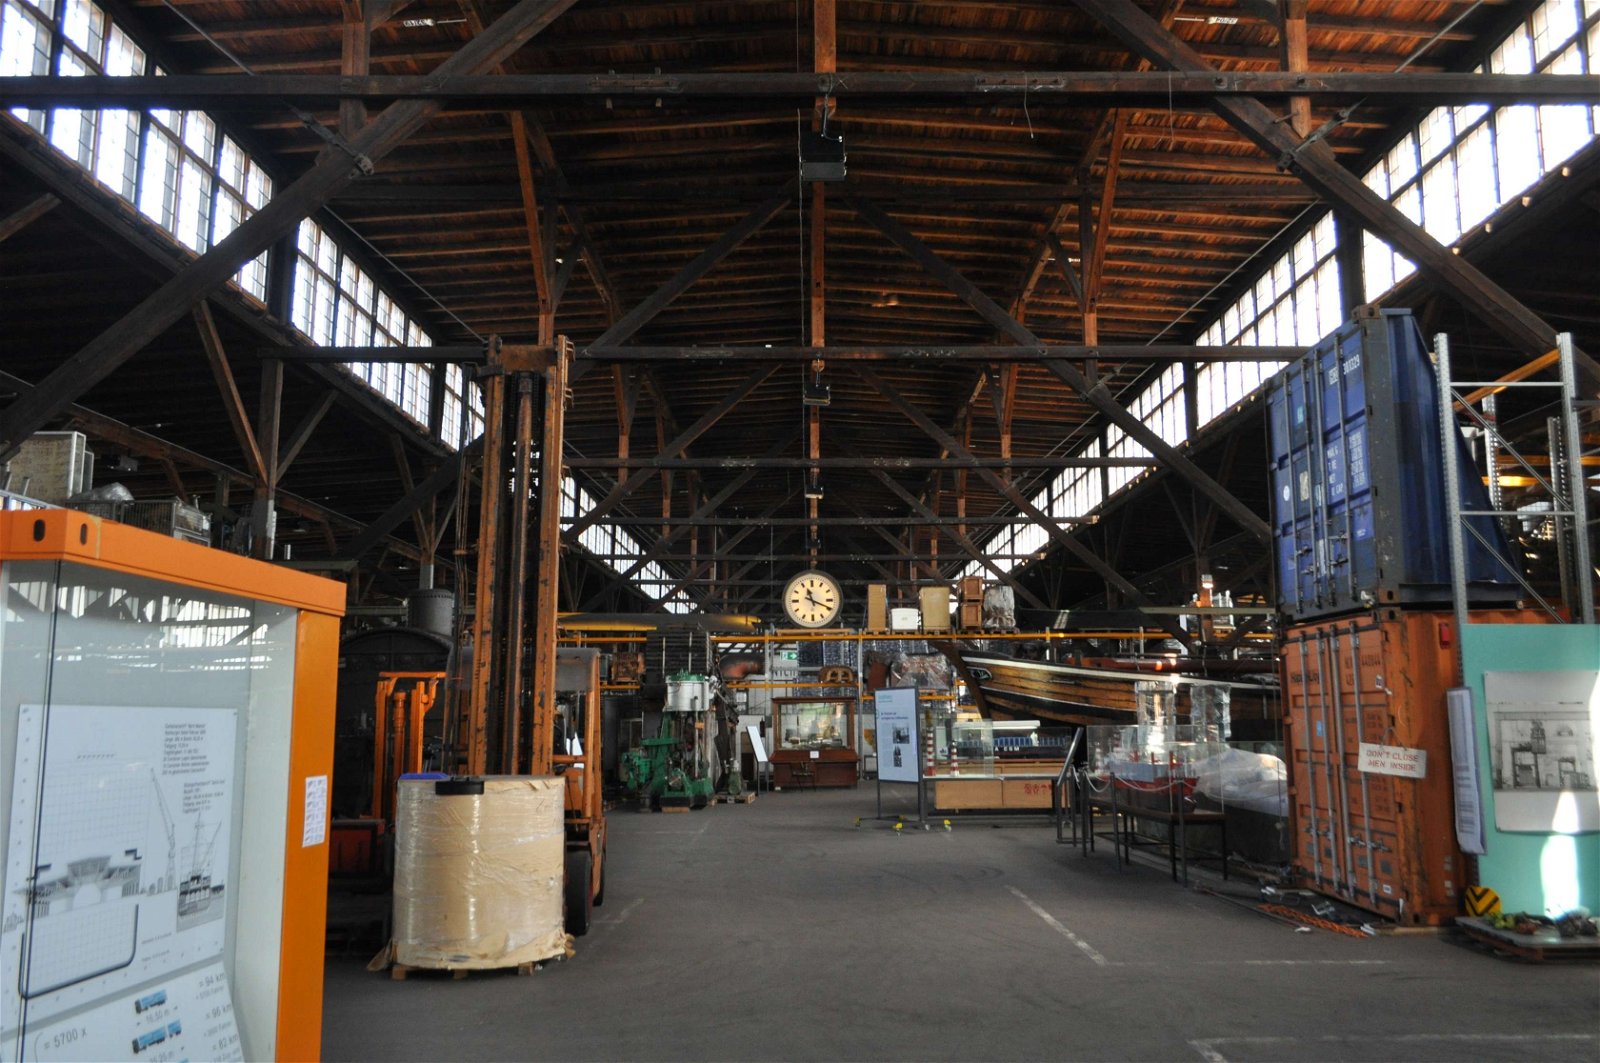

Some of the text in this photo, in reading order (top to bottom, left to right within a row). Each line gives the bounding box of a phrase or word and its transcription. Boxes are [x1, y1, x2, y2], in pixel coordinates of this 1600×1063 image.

[1366, 749, 1418, 762] DON'T CLOSE
[1368, 760, 1417, 771] MEN INSIDE
[54, 1028, 79, 1048] 5700
[81, 1027, 87, 1038] x
